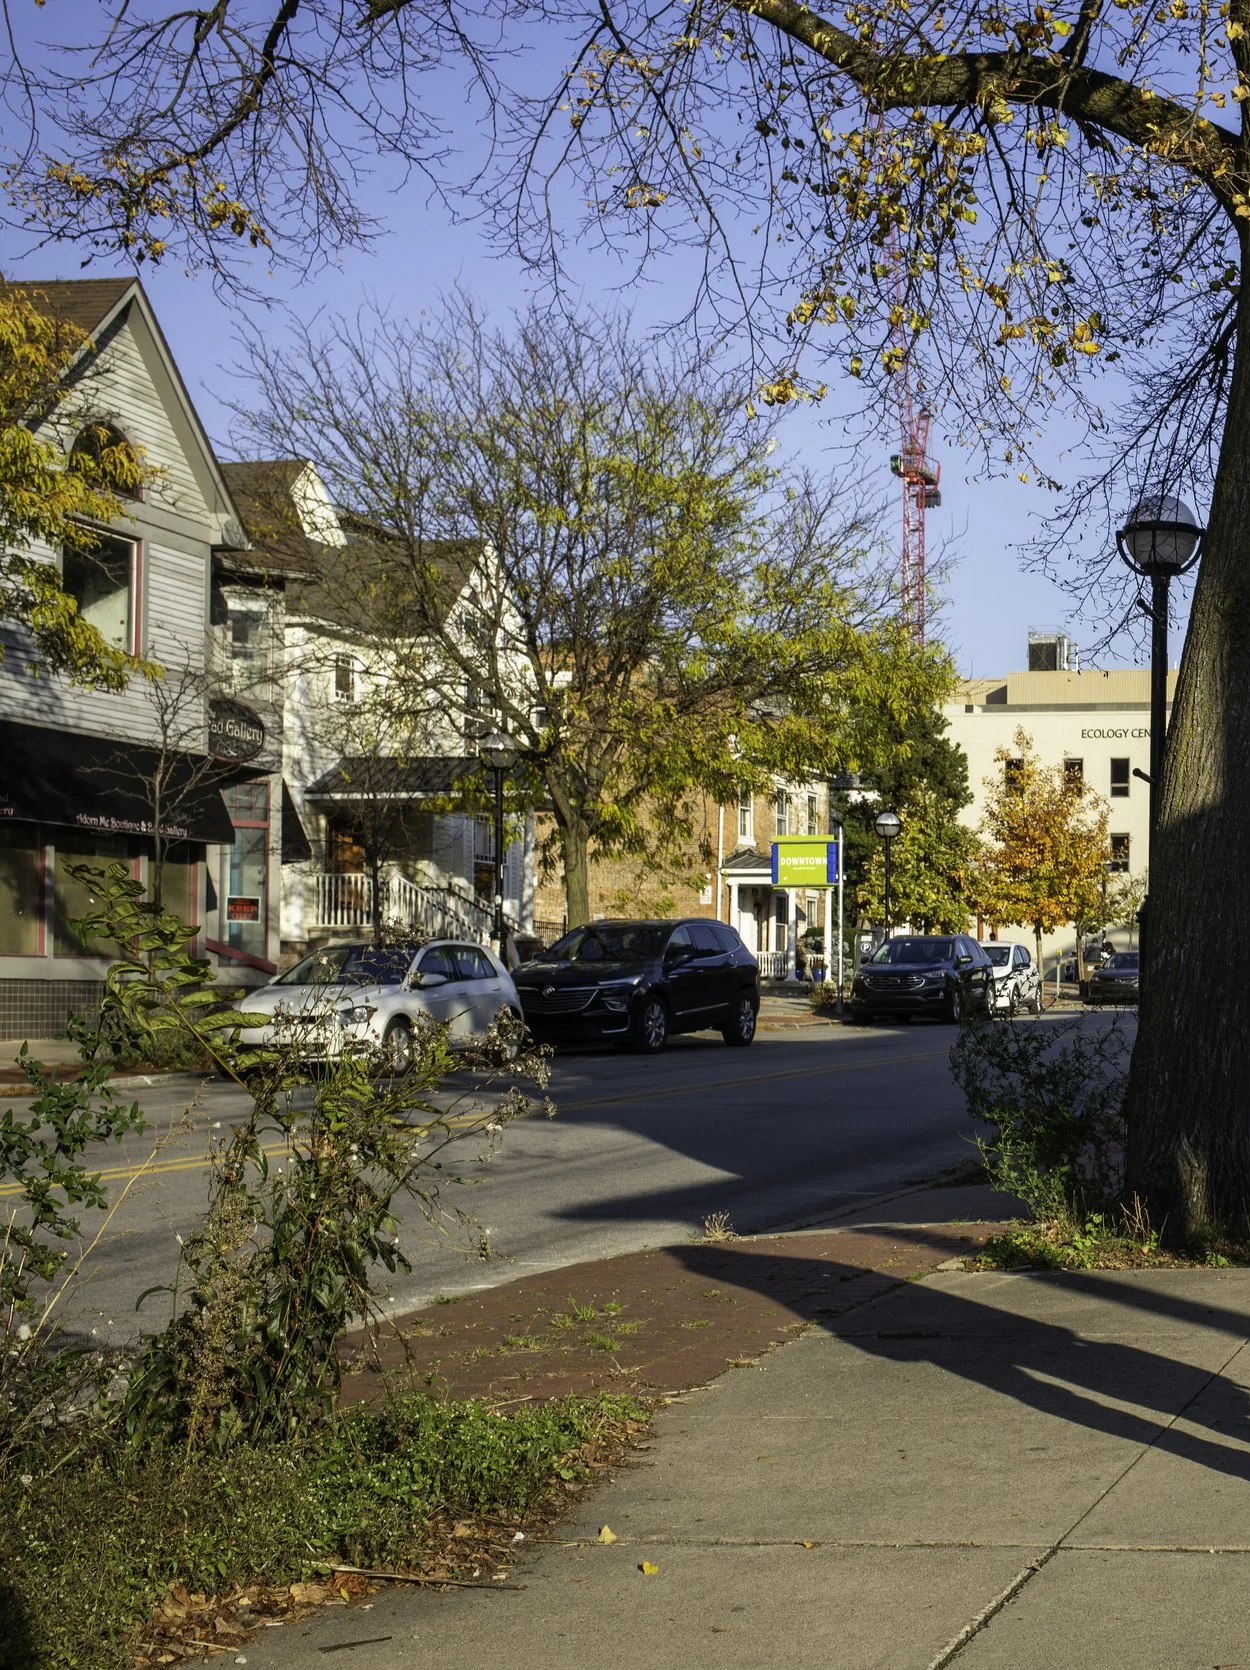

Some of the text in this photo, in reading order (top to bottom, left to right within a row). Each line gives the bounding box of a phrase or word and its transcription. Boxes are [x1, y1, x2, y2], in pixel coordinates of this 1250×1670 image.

[226, 719, 264, 746] Gallery
[1081, 728, 1129, 739] ECOLOGY
[76, 813, 99, 826] Adorn
[780, 856, 828, 866] DOWNTOWN
[228, 904, 257, 912] KEEP
